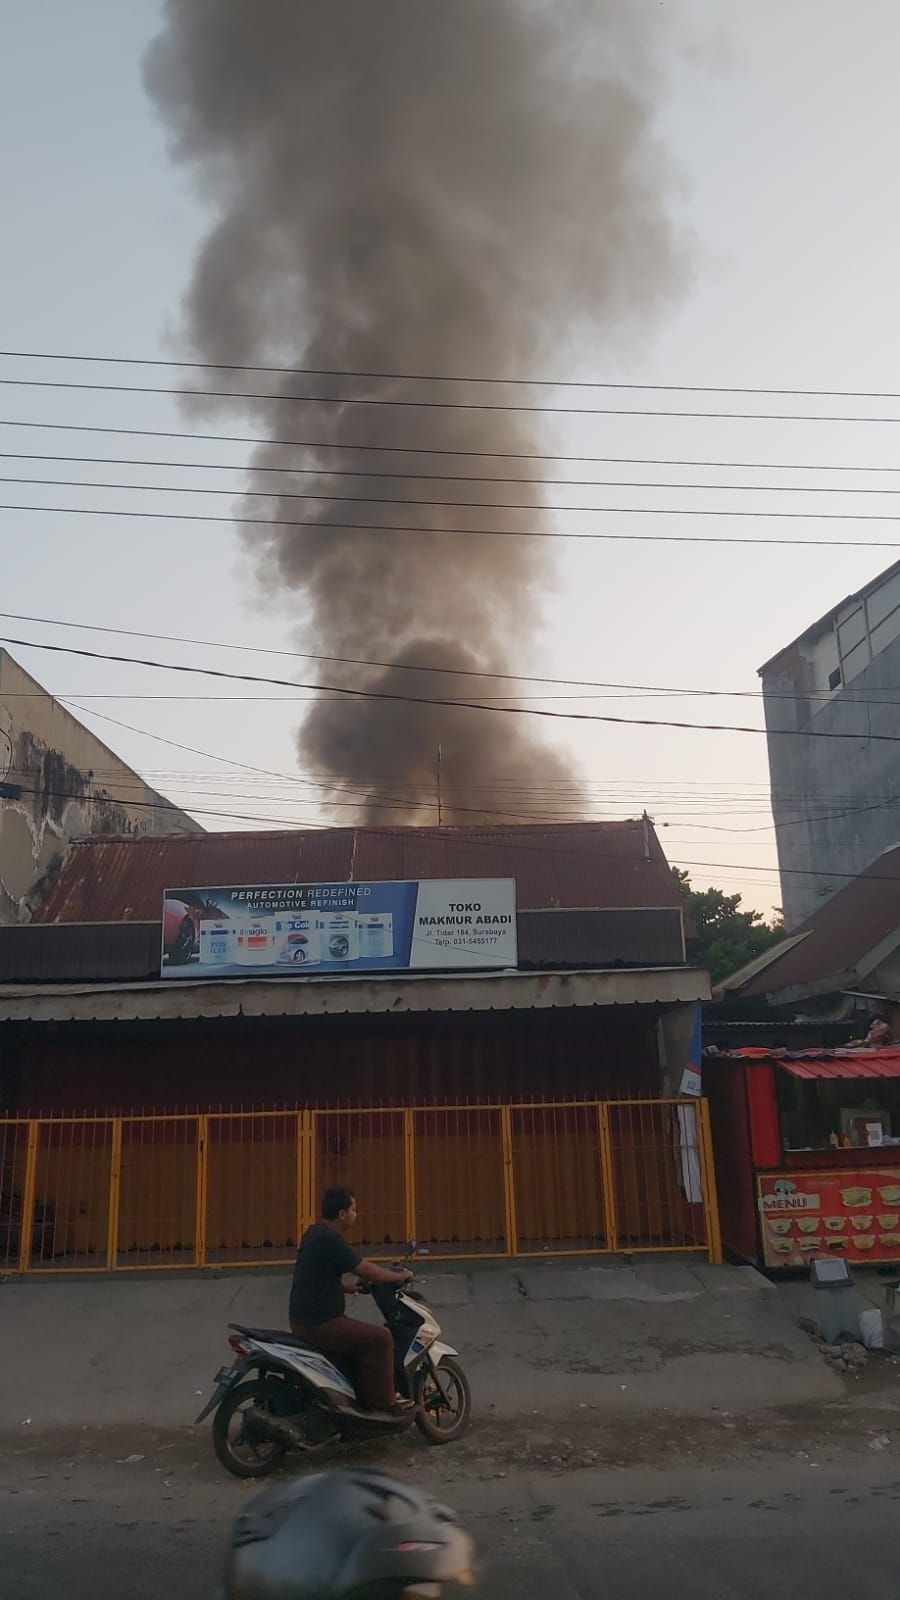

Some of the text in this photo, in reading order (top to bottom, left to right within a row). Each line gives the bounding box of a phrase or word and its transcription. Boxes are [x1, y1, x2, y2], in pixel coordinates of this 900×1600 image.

[231, 887, 371, 900] PERFECTION REDEFINED
[247, 899, 354, 909] AUTOMOTIVE REFINISH
[448, 903, 482, 912] TOKO
[419, 915, 512, 925] MAKMUR ABADI
[473, 928, 506, 937] Surabaya
[763, 1198, 806, 1209] MENU
